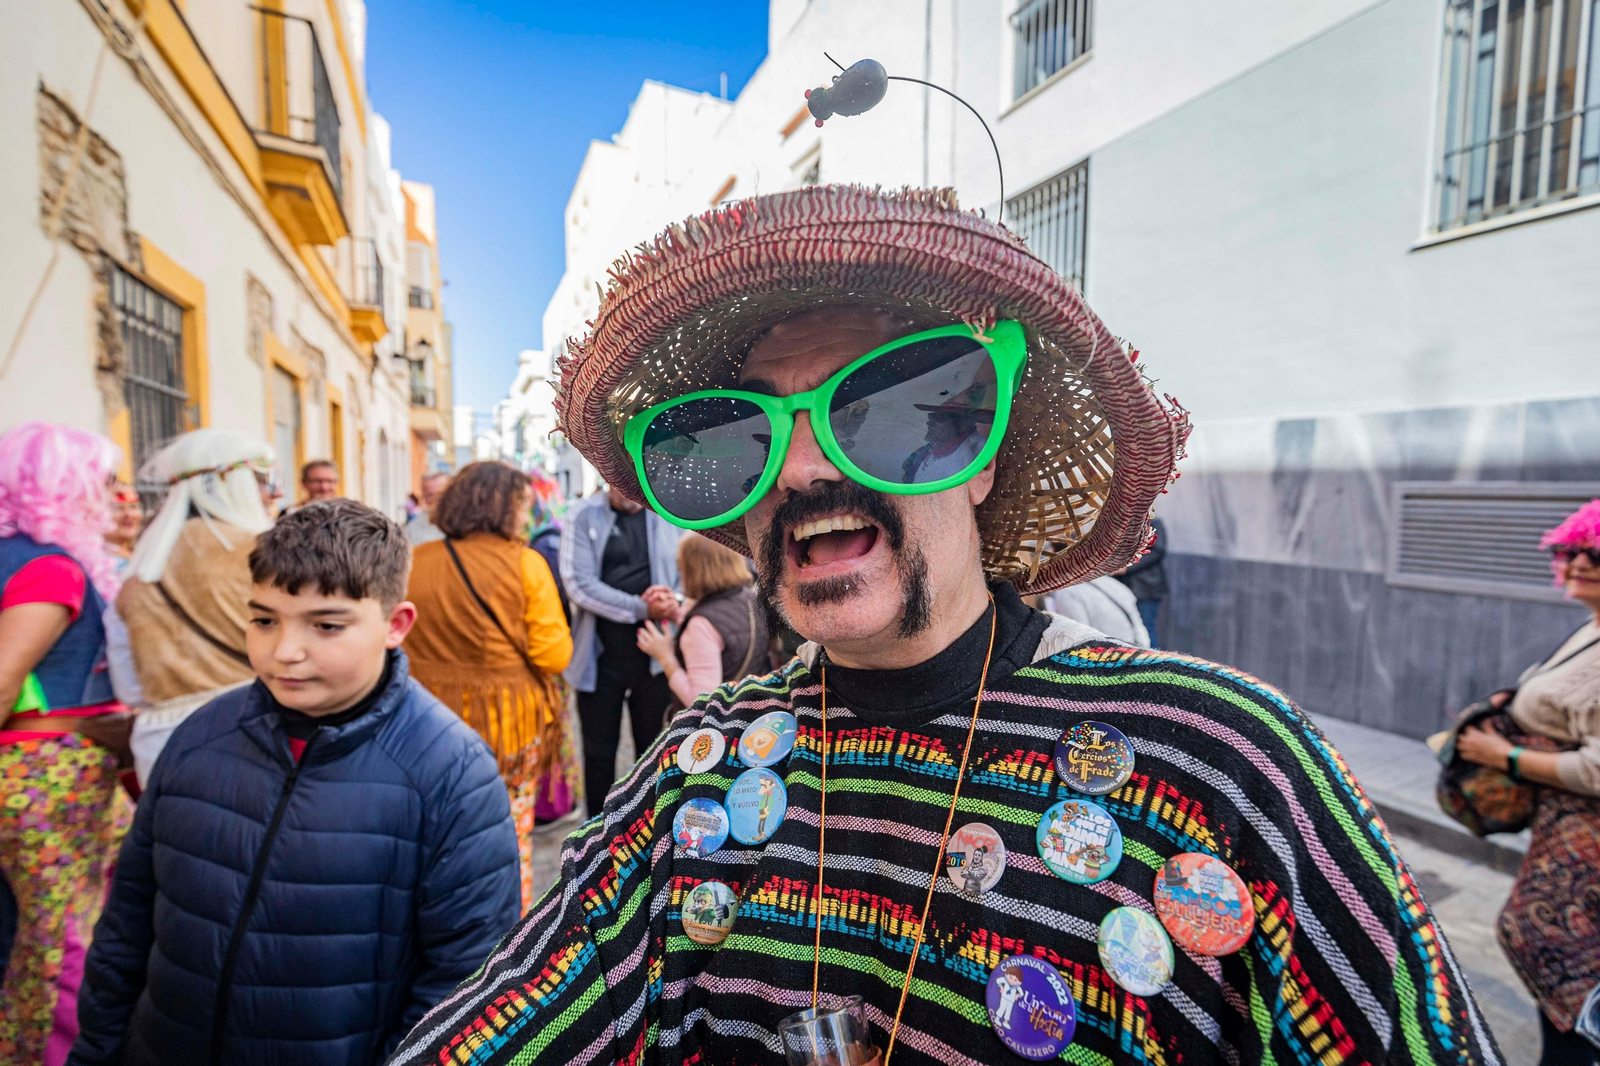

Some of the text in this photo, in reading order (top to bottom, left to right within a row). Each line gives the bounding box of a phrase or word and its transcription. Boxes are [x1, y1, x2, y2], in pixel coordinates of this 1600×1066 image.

[1086, 730, 1116, 752] Los
[1069, 764, 1079, 774] de
[1089, 781, 1118, 793] CARNAVAL
[738, 800, 759, 808] VUELVO
[945, 855, 967, 868] 2019
[1000, 958, 1069, 1006] CARNAVAL 2022
[1005, 1037, 1056, 1057] CALLEJERO
